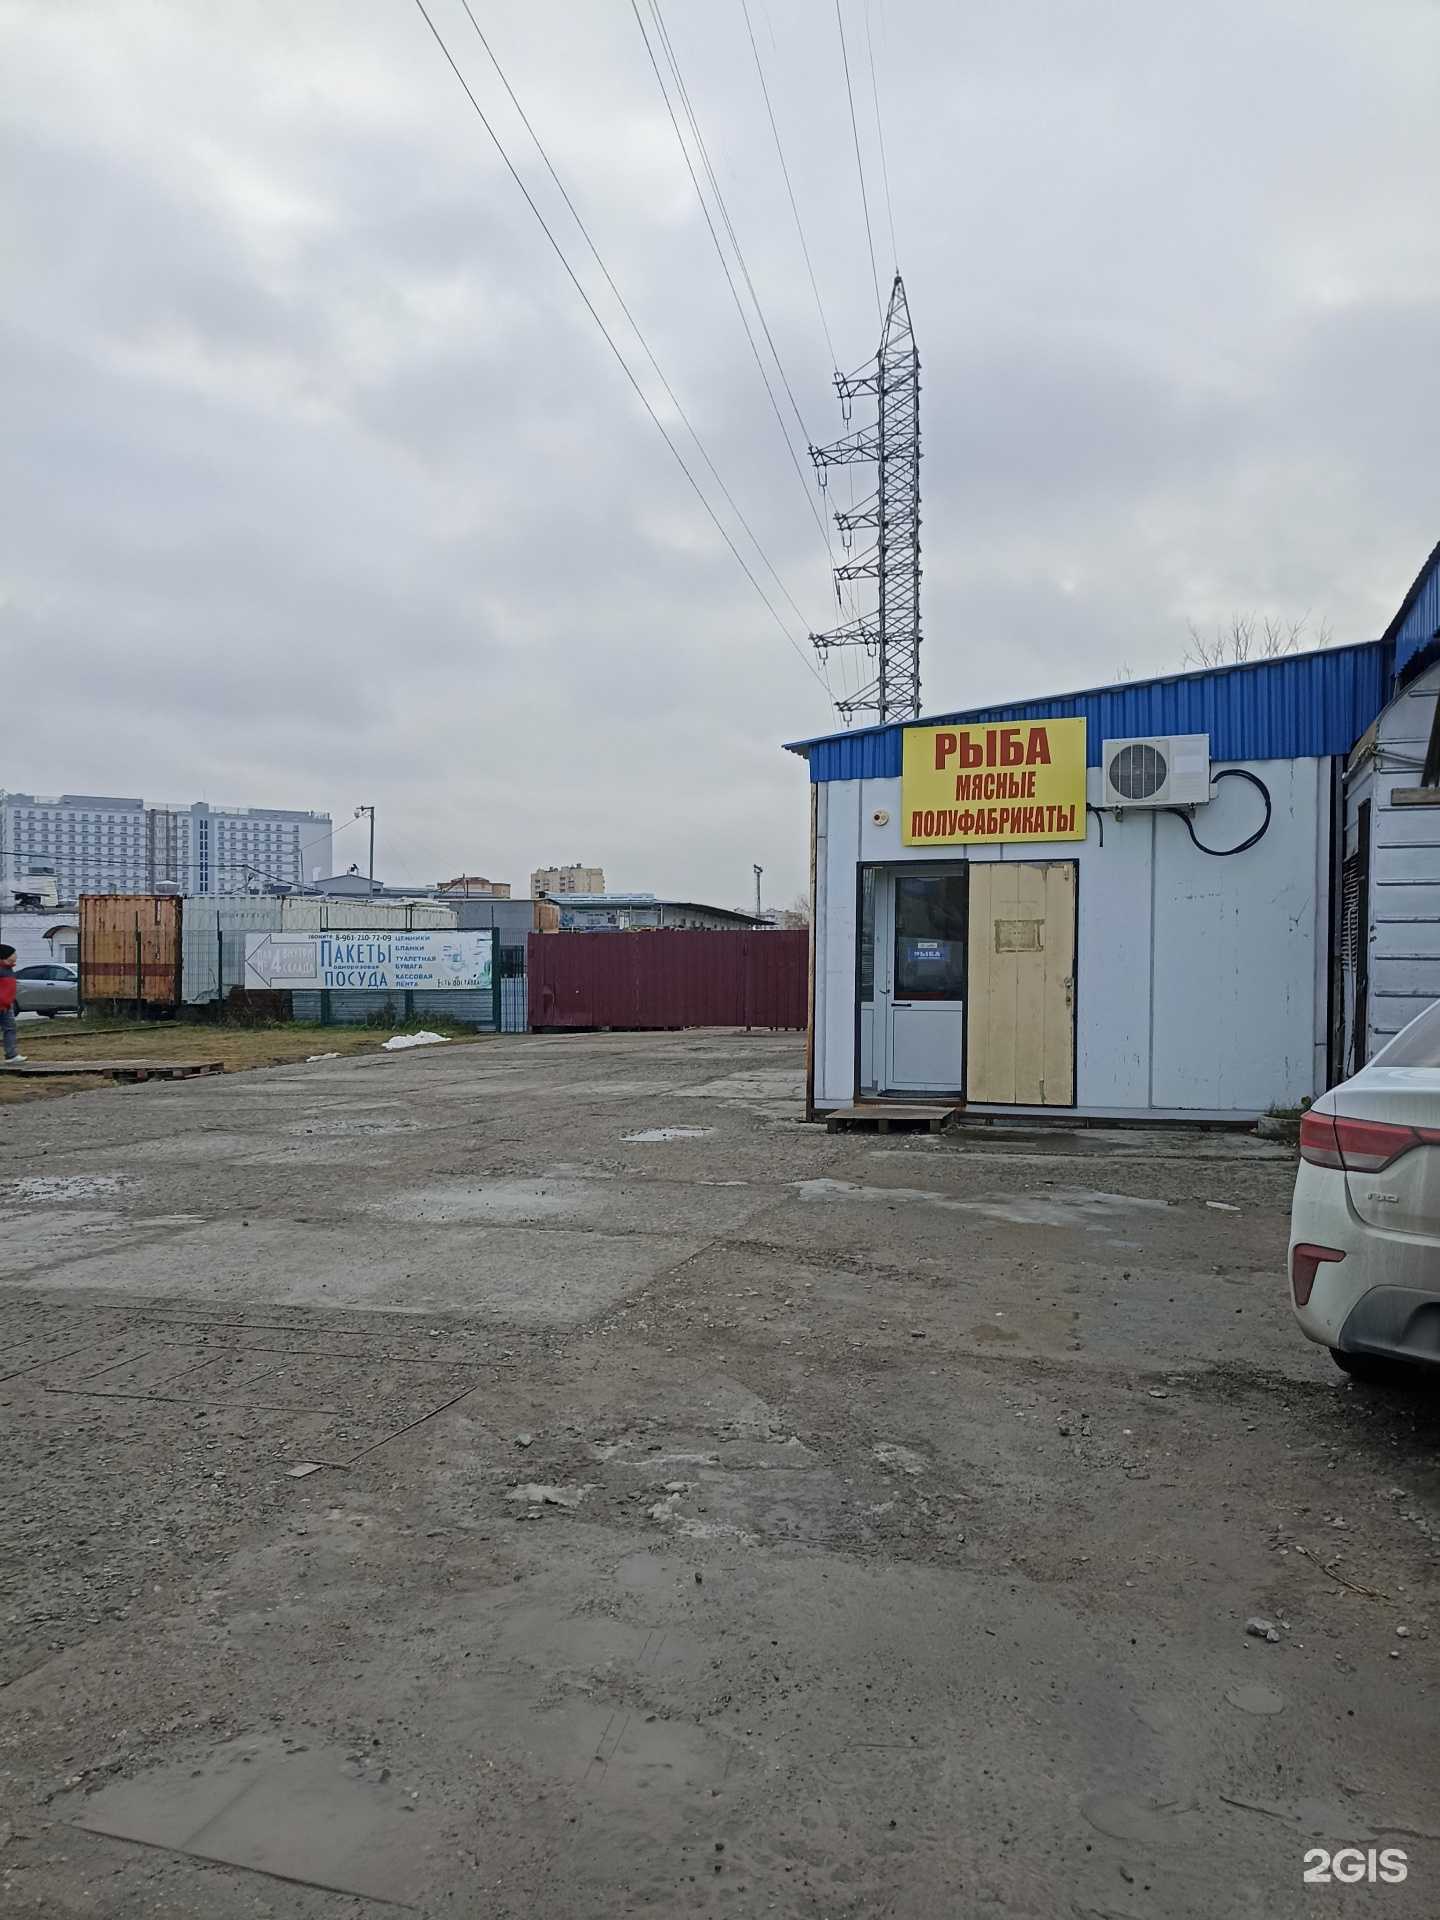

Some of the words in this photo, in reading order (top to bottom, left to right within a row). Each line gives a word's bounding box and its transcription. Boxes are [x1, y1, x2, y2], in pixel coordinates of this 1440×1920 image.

[935, 727, 1051, 770] РЫБА
[955, 771, 1036, 801] МЯСНЫЕ
[911, 804, 1076, 838] ПОЛУФАБРИКАТЫ
[324, 970, 388, 990] ПОСУДА
